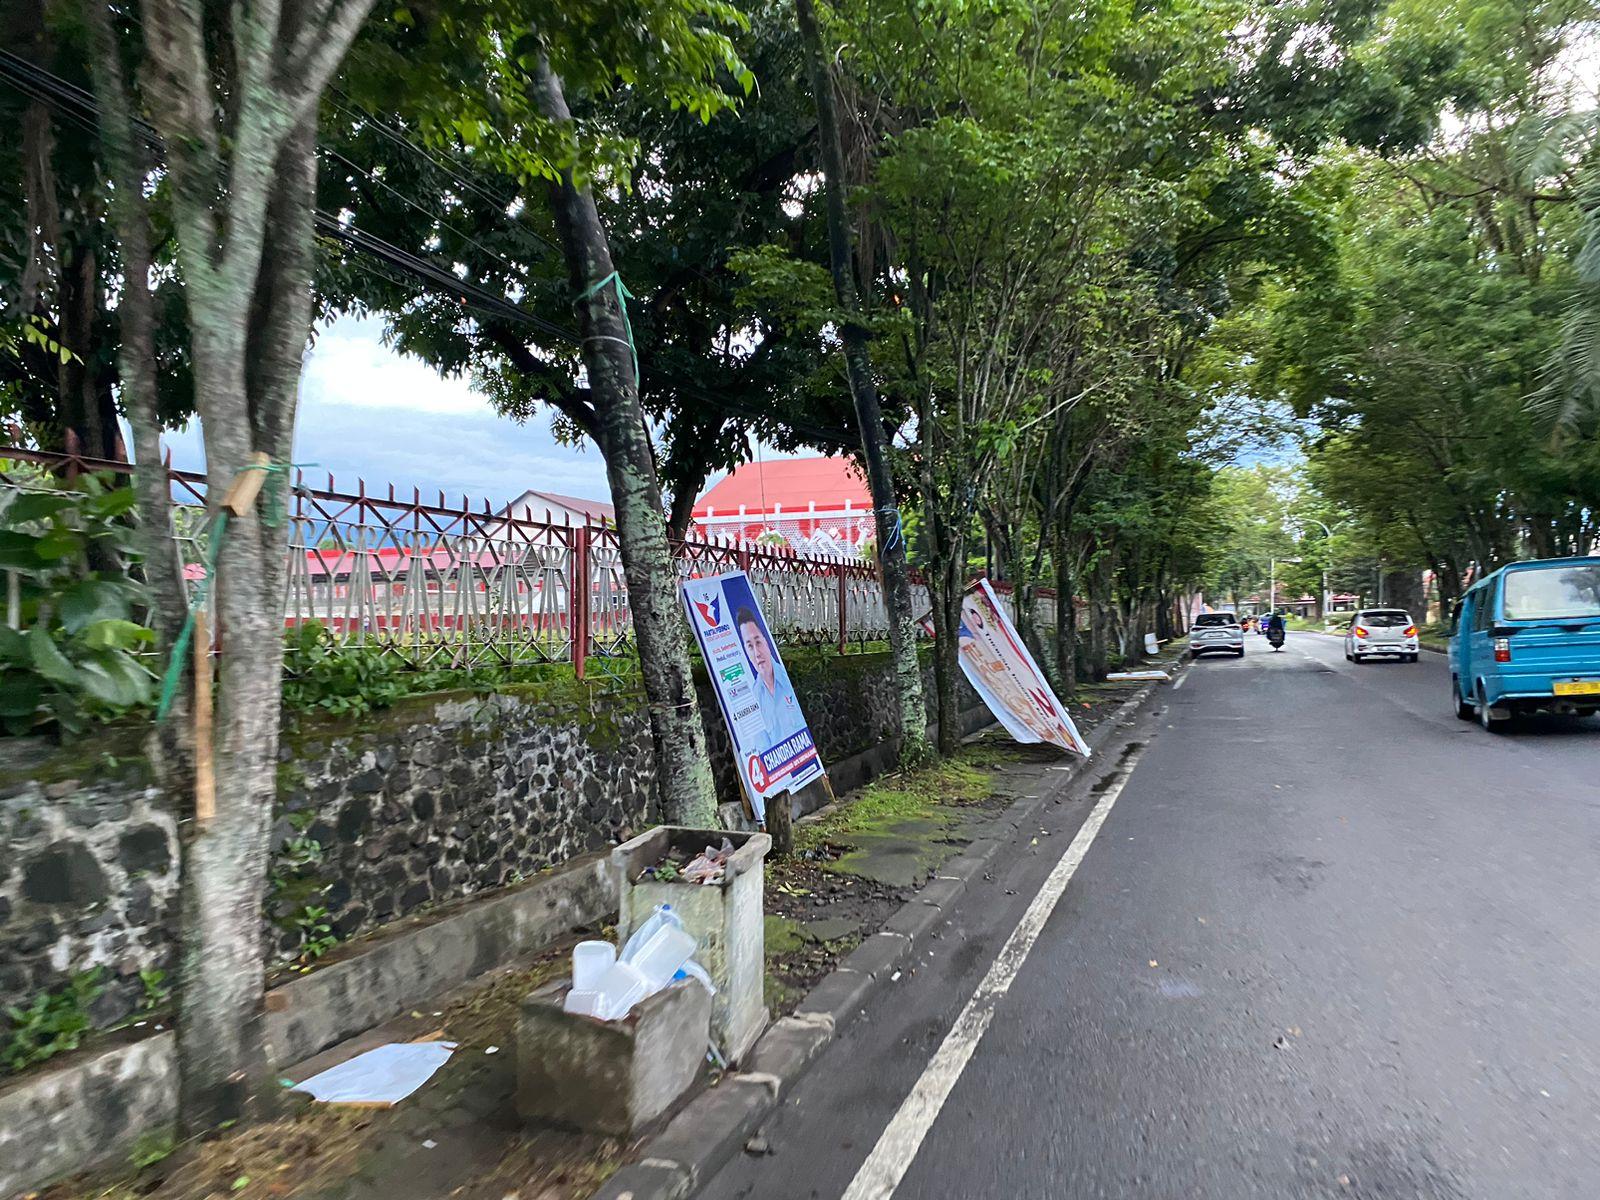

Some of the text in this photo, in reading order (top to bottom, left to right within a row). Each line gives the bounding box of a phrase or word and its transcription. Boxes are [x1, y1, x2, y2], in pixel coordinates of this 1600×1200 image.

[764, 741, 794, 771] CHANDRA
[791, 731, 812, 754] RAMA
[751, 759, 765, 787] 4
